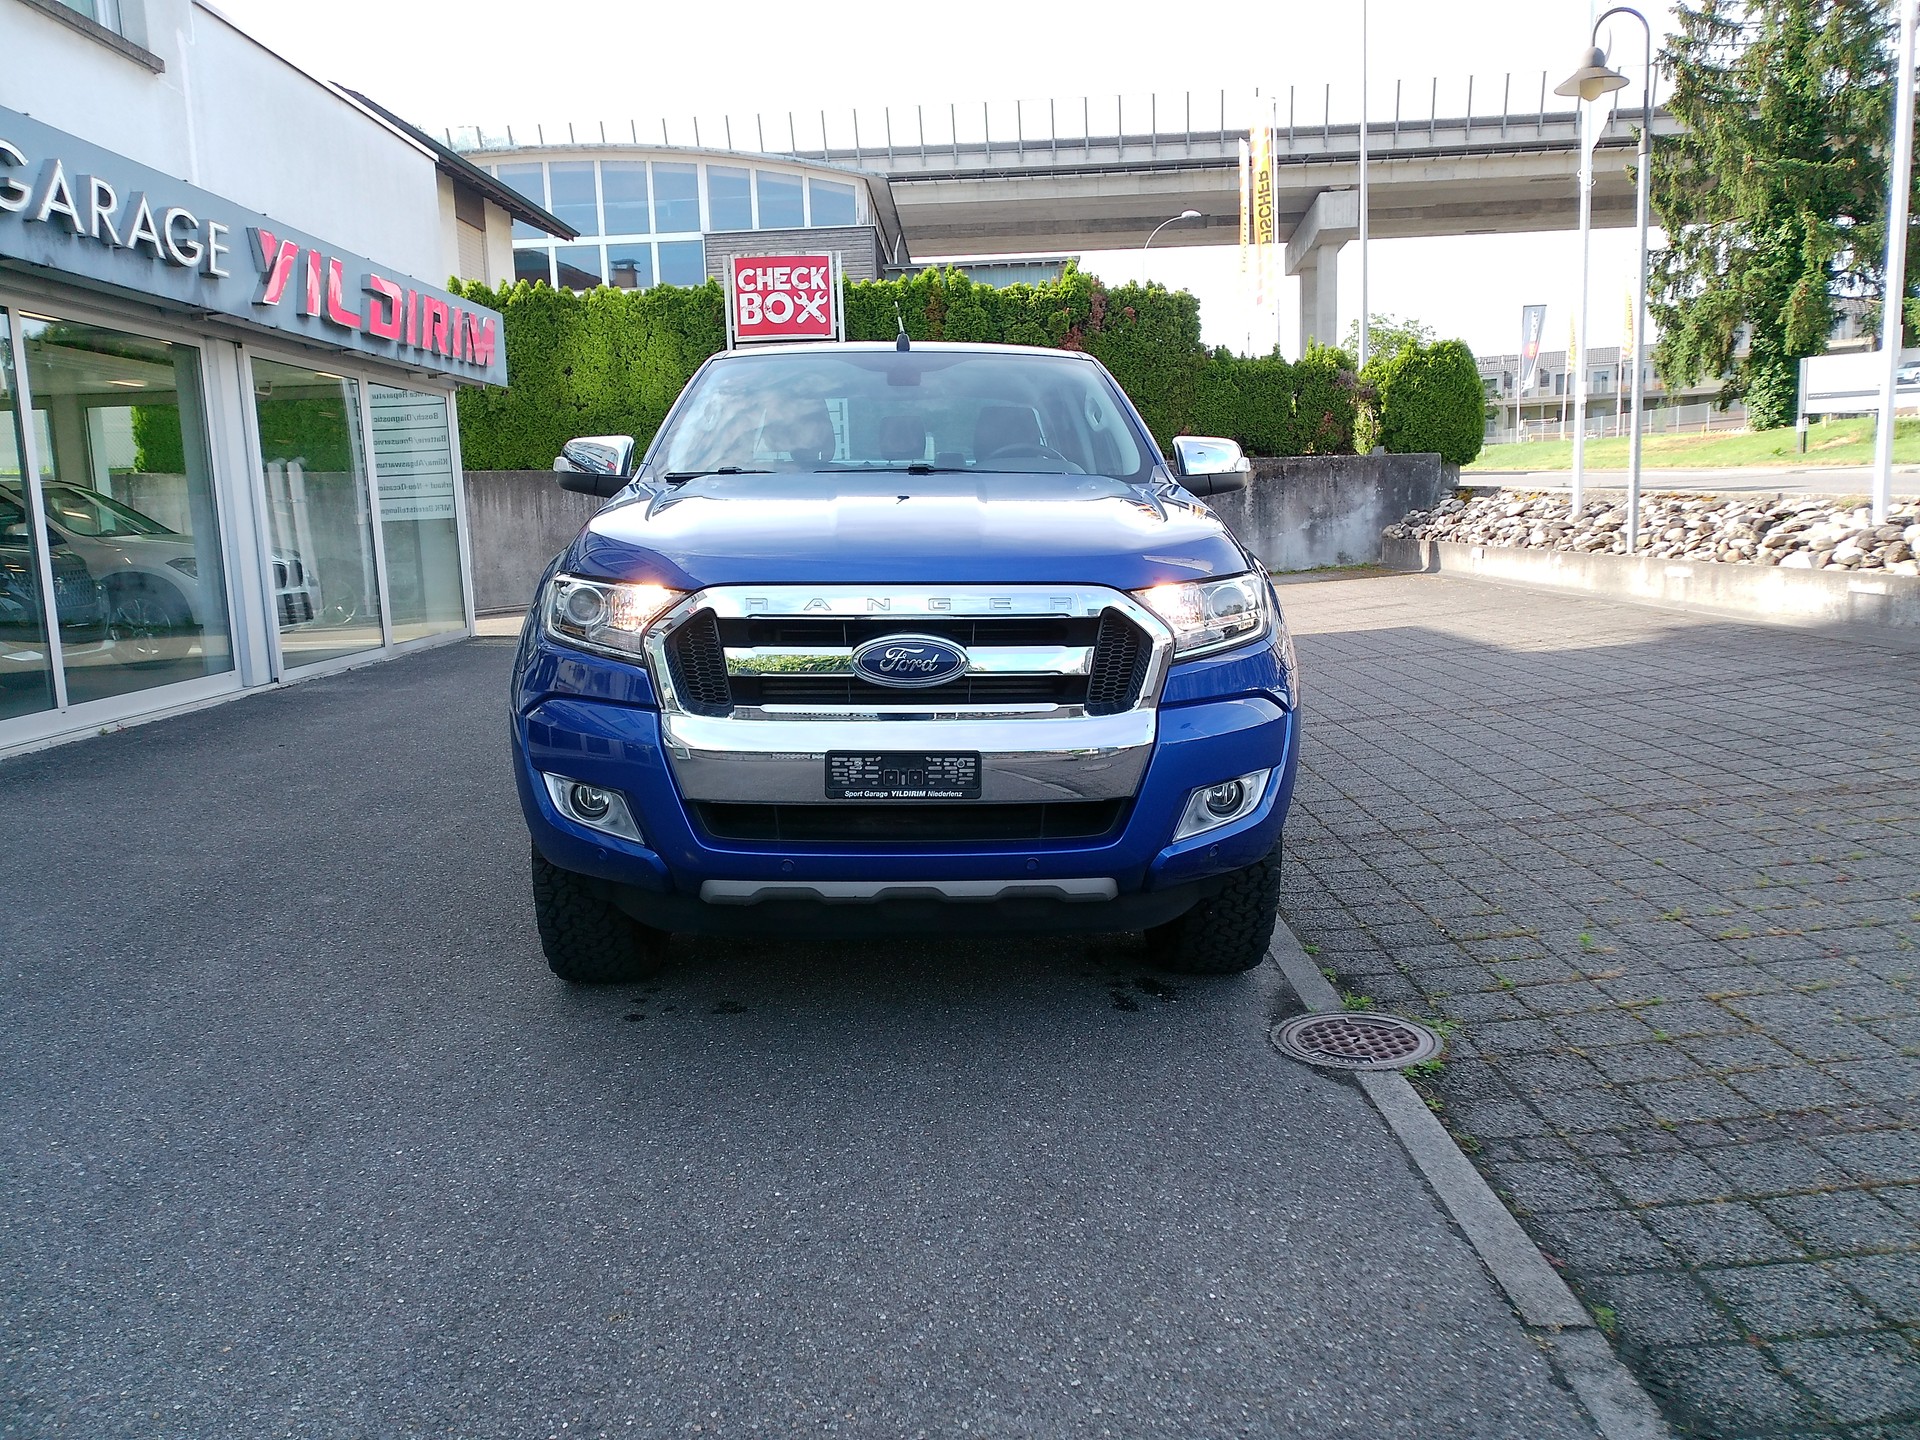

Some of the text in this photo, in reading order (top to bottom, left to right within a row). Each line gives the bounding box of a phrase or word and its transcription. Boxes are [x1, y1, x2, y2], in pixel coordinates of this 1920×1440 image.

[0, 138, 496, 367] GARAGE YILDIRIM
[738, 266, 828, 291] CHECK
[745, 596, 1073, 612] RANGER
[879, 646, 939, 673] Ford
[844, 790, 863, 798] Sport
[864, 790, 888, 798] Garage
